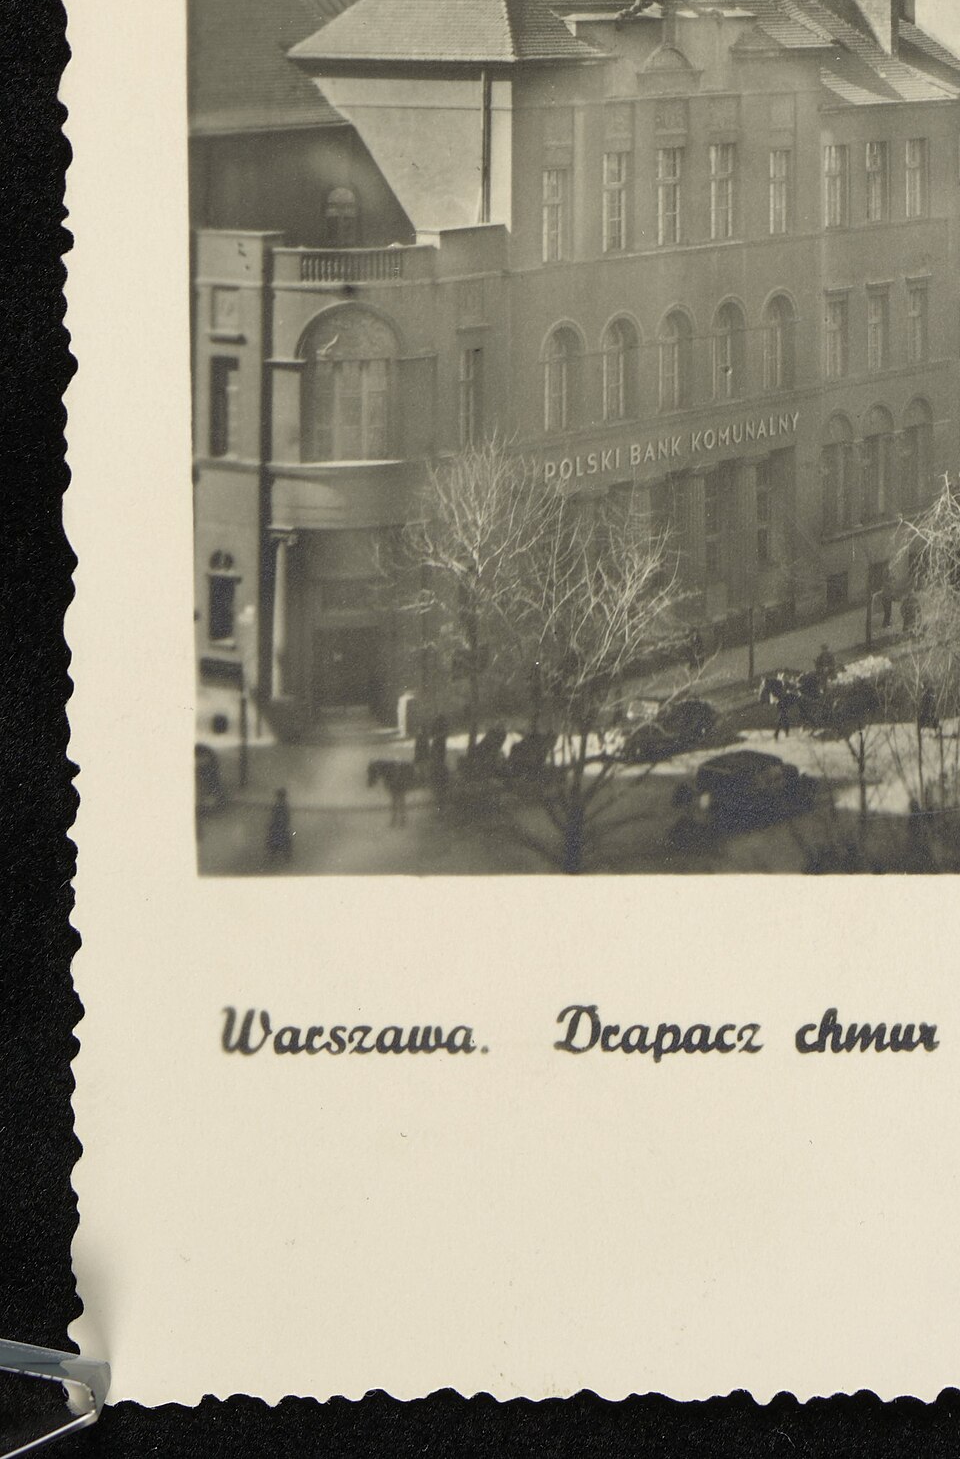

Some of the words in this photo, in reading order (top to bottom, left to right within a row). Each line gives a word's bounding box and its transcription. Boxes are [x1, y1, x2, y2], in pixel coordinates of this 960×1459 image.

[544, 448, 620, 483] POLSKI
[630, 435, 682, 466] BANK
[691, 412, 800, 450] KOMUNALNY
